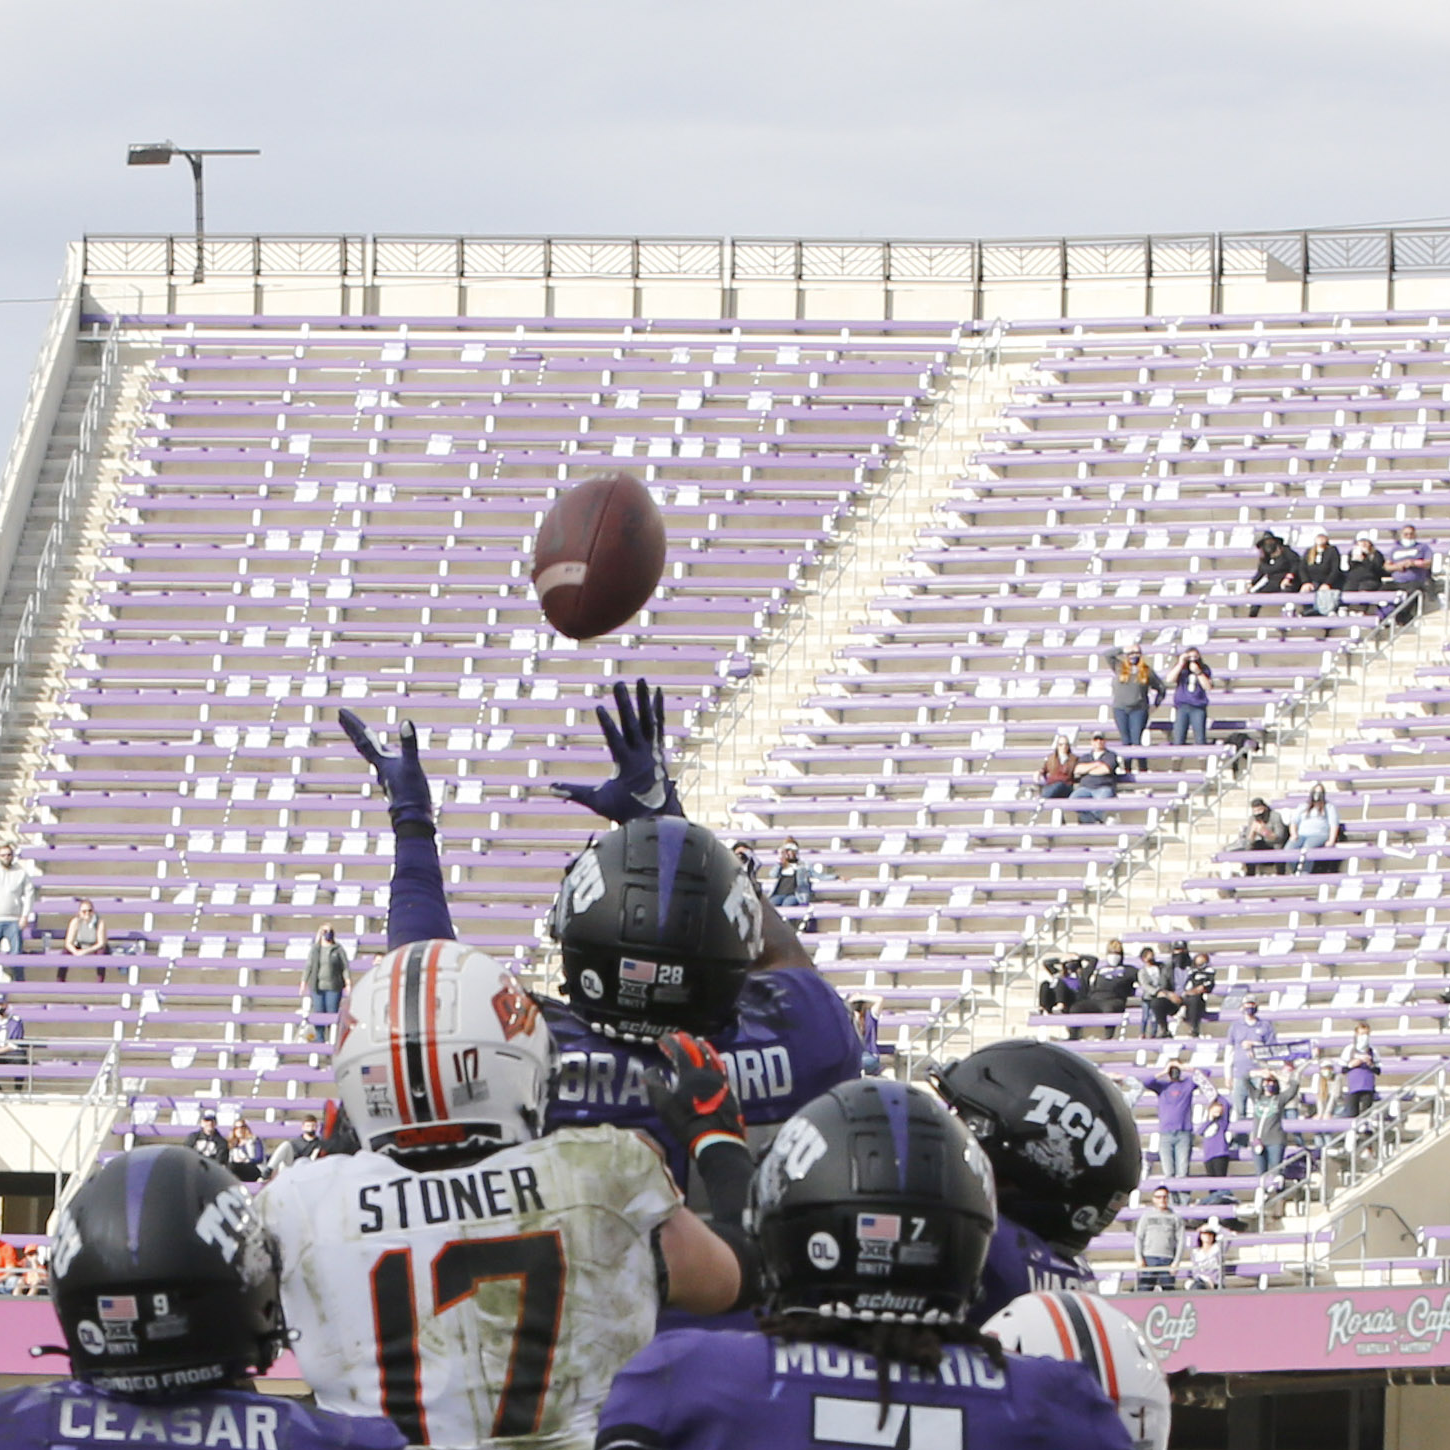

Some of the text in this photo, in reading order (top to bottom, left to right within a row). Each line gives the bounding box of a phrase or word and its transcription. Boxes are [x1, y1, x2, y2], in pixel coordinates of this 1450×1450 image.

[658, 964, 684, 985] 28
[1024, 1085, 1118, 1167] TCU
[359, 1167, 544, 1234] STONER
[910, 1217, 926, 1241] 7
[811, 1241, 835, 1261] DL
[153, 1293, 170, 1315] 9
[855, 1292, 926, 1311] schutt
[1145, 1302, 1198, 1345] Café
[1326, 1299, 1397, 1353] Rosa's
[369, 1230, 567, 1446] 17
[162, 1364, 225, 1388] FROGS
